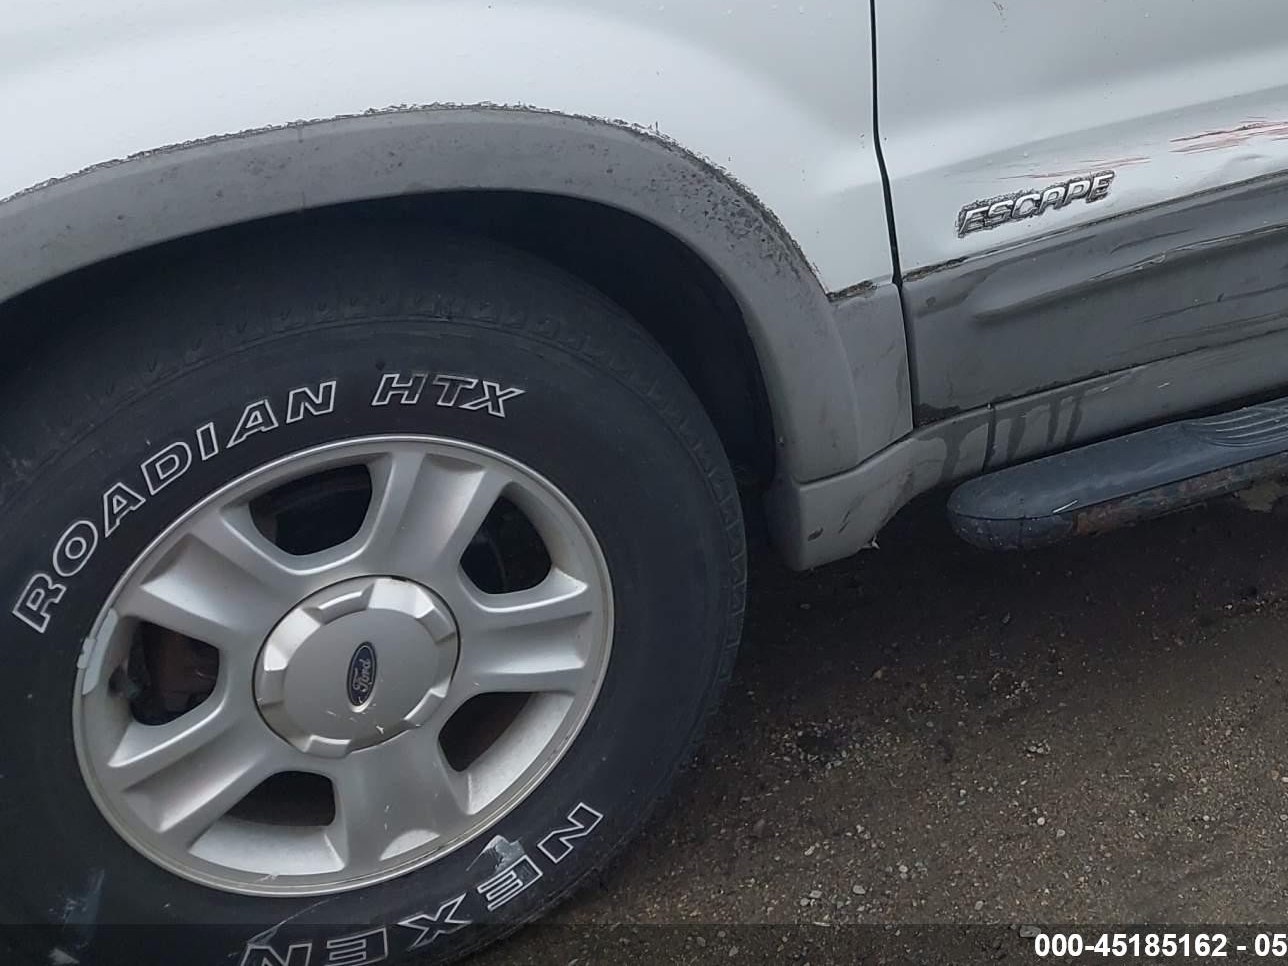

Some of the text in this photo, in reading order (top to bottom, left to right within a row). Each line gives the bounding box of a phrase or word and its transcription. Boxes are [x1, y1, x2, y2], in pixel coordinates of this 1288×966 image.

[957, 169, 1116, 238] ESCAPE
[11, 372, 526, 634] ROADIAN HTX
[239, 801, 604, 966] NEXEN
